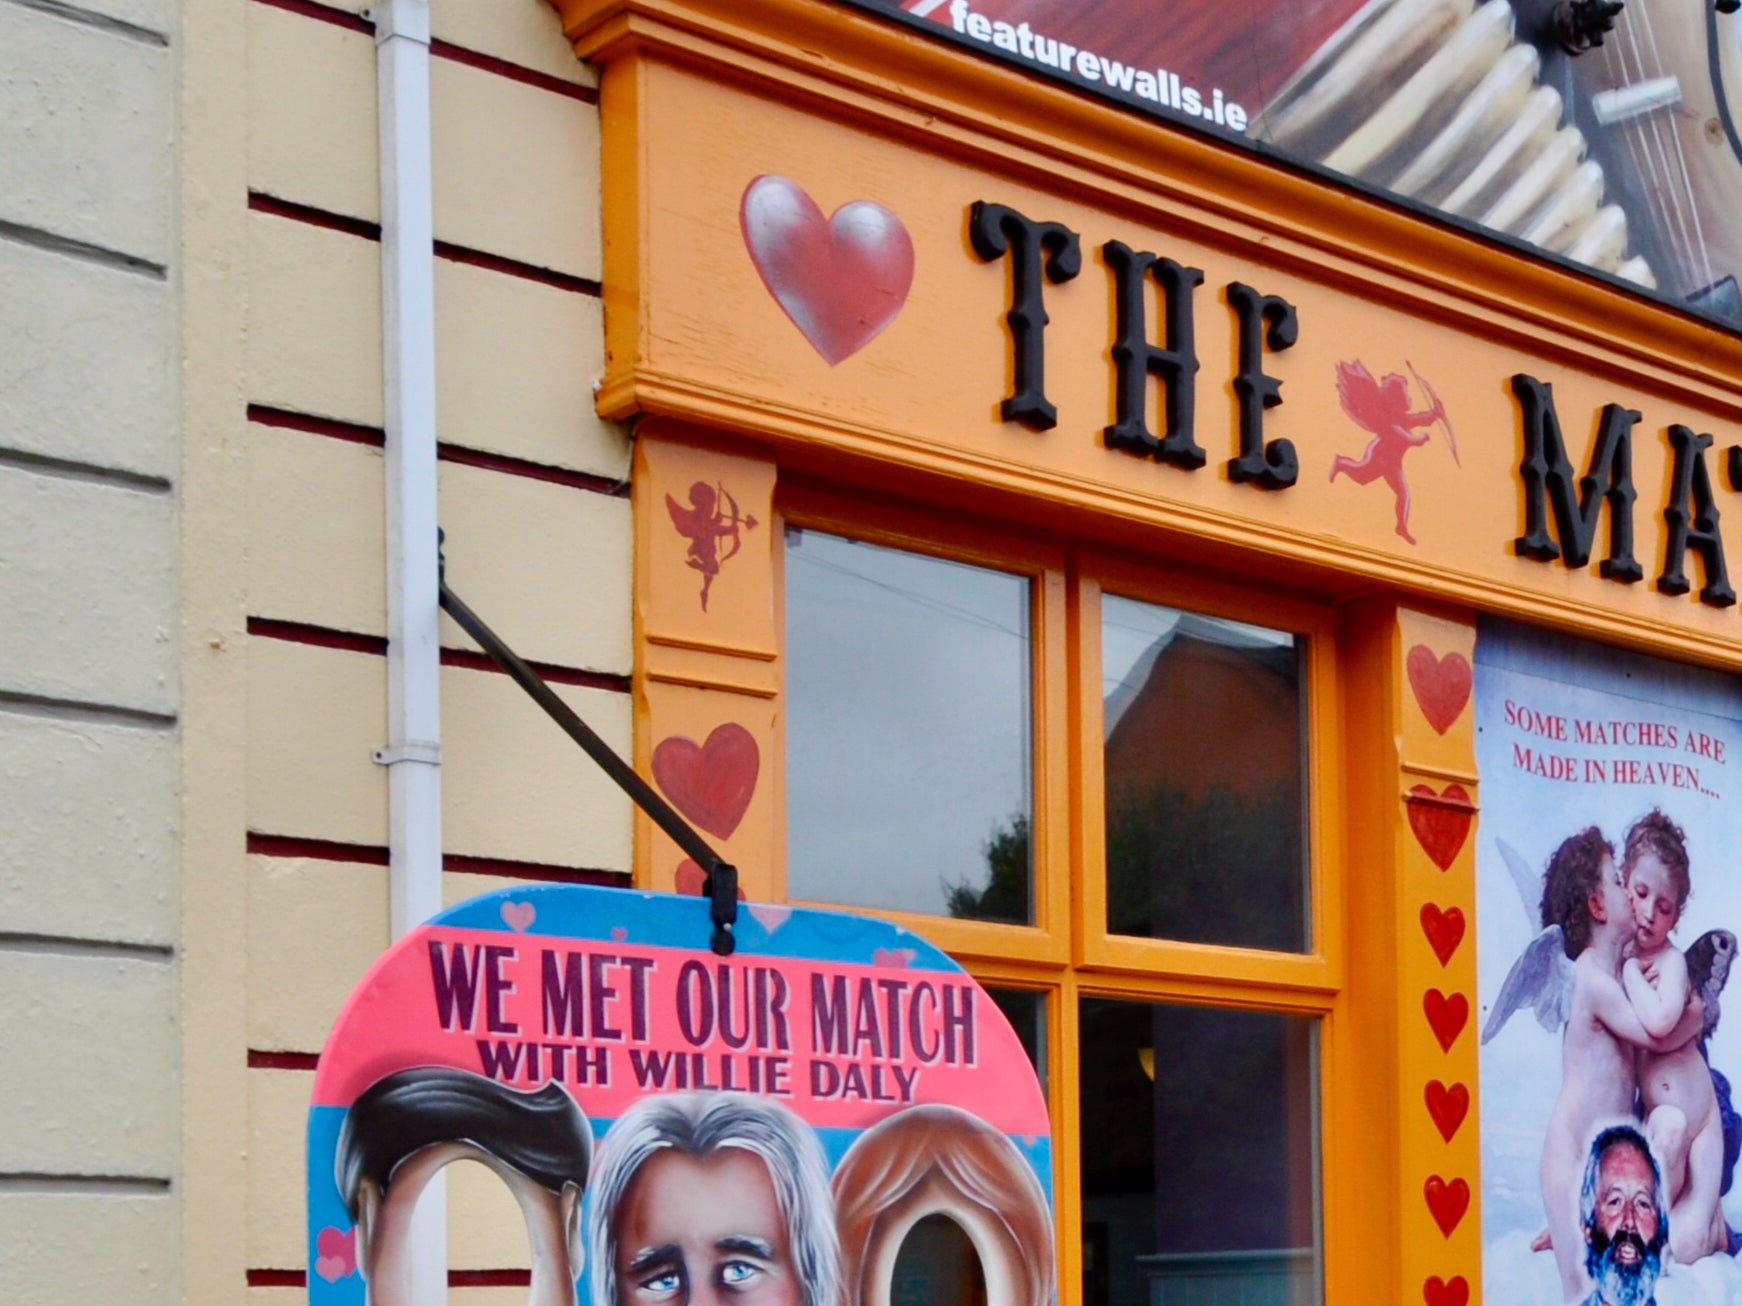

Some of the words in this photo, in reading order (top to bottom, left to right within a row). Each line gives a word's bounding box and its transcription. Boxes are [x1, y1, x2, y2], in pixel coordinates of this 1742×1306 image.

[950, 0, 1248, 131] featurewalls.ie
[970, 200, 1298, 491] THE
[1504, 699, 1567, 742] SOME
[1574, 719, 1679, 749] MATCHES
[1684, 730, 1726, 764] ARE
[1512, 743, 1577, 783] MADE
[1584, 759, 1607, 783] IN
[428, 940, 522, 1035] WE
[541, 950, 657, 1043] MET
[676, 959, 793, 1054] OUR
[811, 972, 978, 1068] MATCH
[476, 1040, 611, 1087] WITH
[629, 1048, 793, 1096] WILLIE
[809, 1060, 921, 1102] DALY
